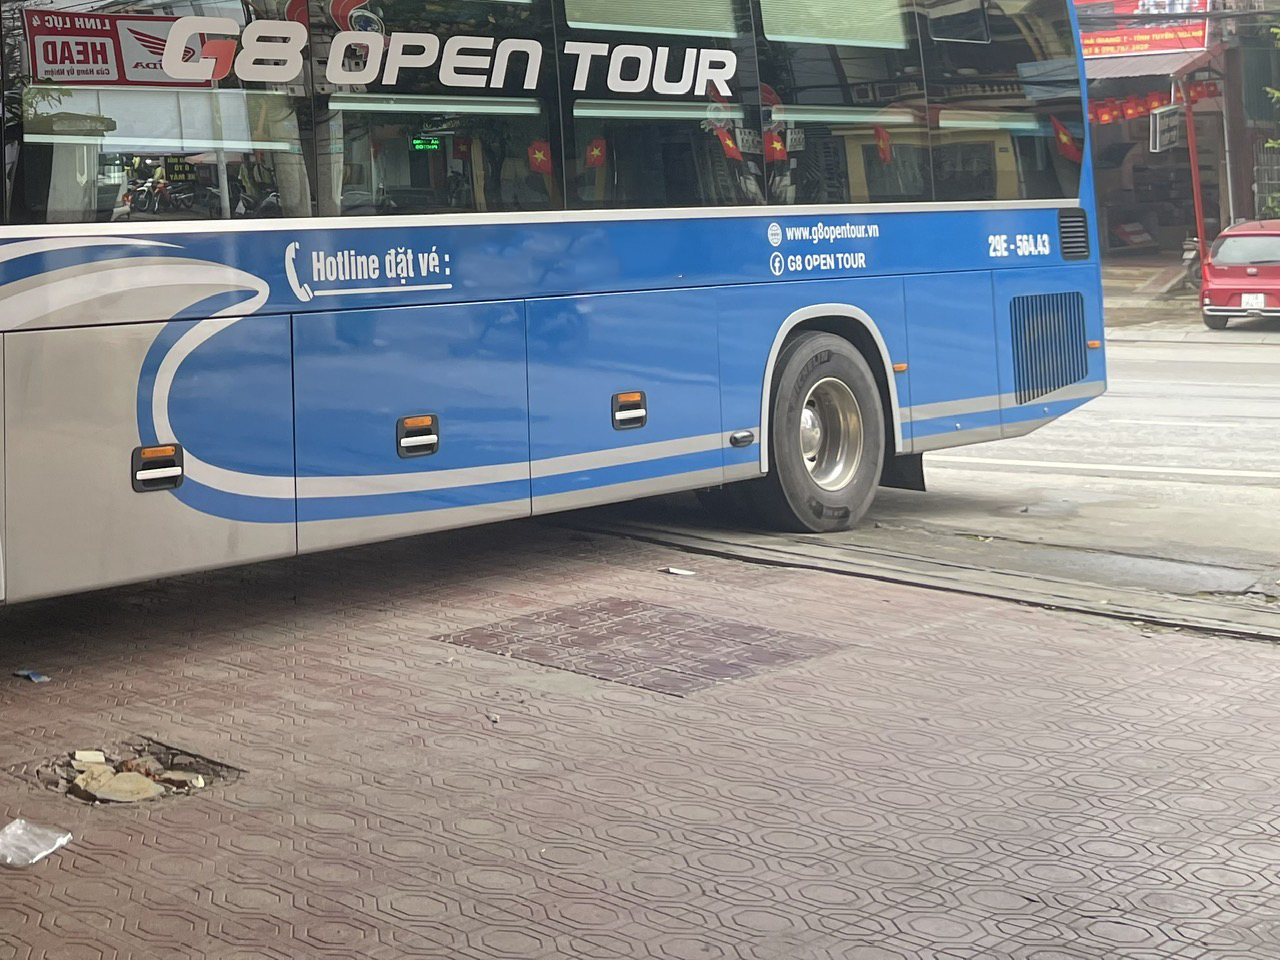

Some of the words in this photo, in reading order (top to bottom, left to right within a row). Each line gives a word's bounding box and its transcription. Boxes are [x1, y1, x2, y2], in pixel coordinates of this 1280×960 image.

[162, 16, 308, 82] G8
[325, 30, 543, 90] OPEN
[563, 41, 737, 97] TOUR
[785, 222, 879, 244] www.g8opentour.vn
[988, 234, 1009, 257] 29E
[1016, 233, 1051, 257] 564.43
[312, 250, 380, 282] Hotline
[385, 246, 415, 284] đặt
[787, 254, 803, 271] G8
[805, 253, 835, 270] OPEN
[836, 252, 866, 269] TOUR
